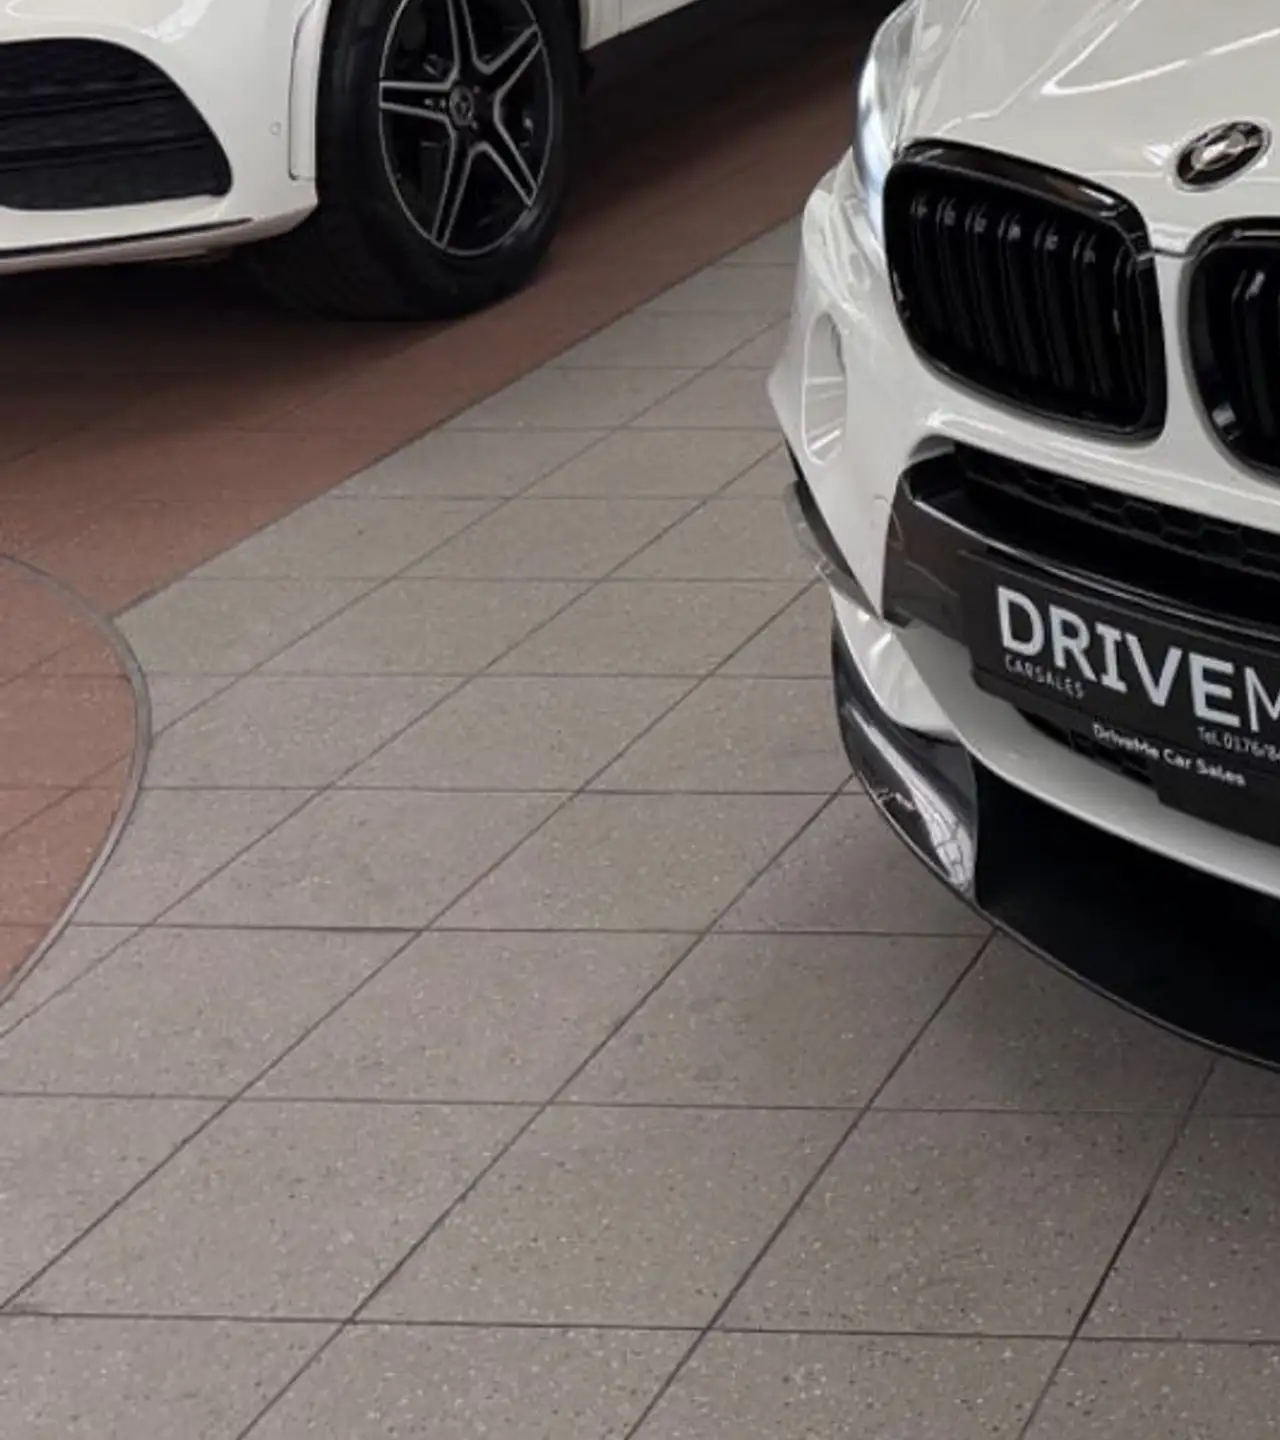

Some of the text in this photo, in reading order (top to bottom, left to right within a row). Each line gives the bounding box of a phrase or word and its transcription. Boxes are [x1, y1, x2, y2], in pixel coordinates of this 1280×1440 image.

[1004, 653, 1084, 700] CARSALES
[1162, 747, 1193, 770] Car
[1197, 757, 1247, 787] Sales
